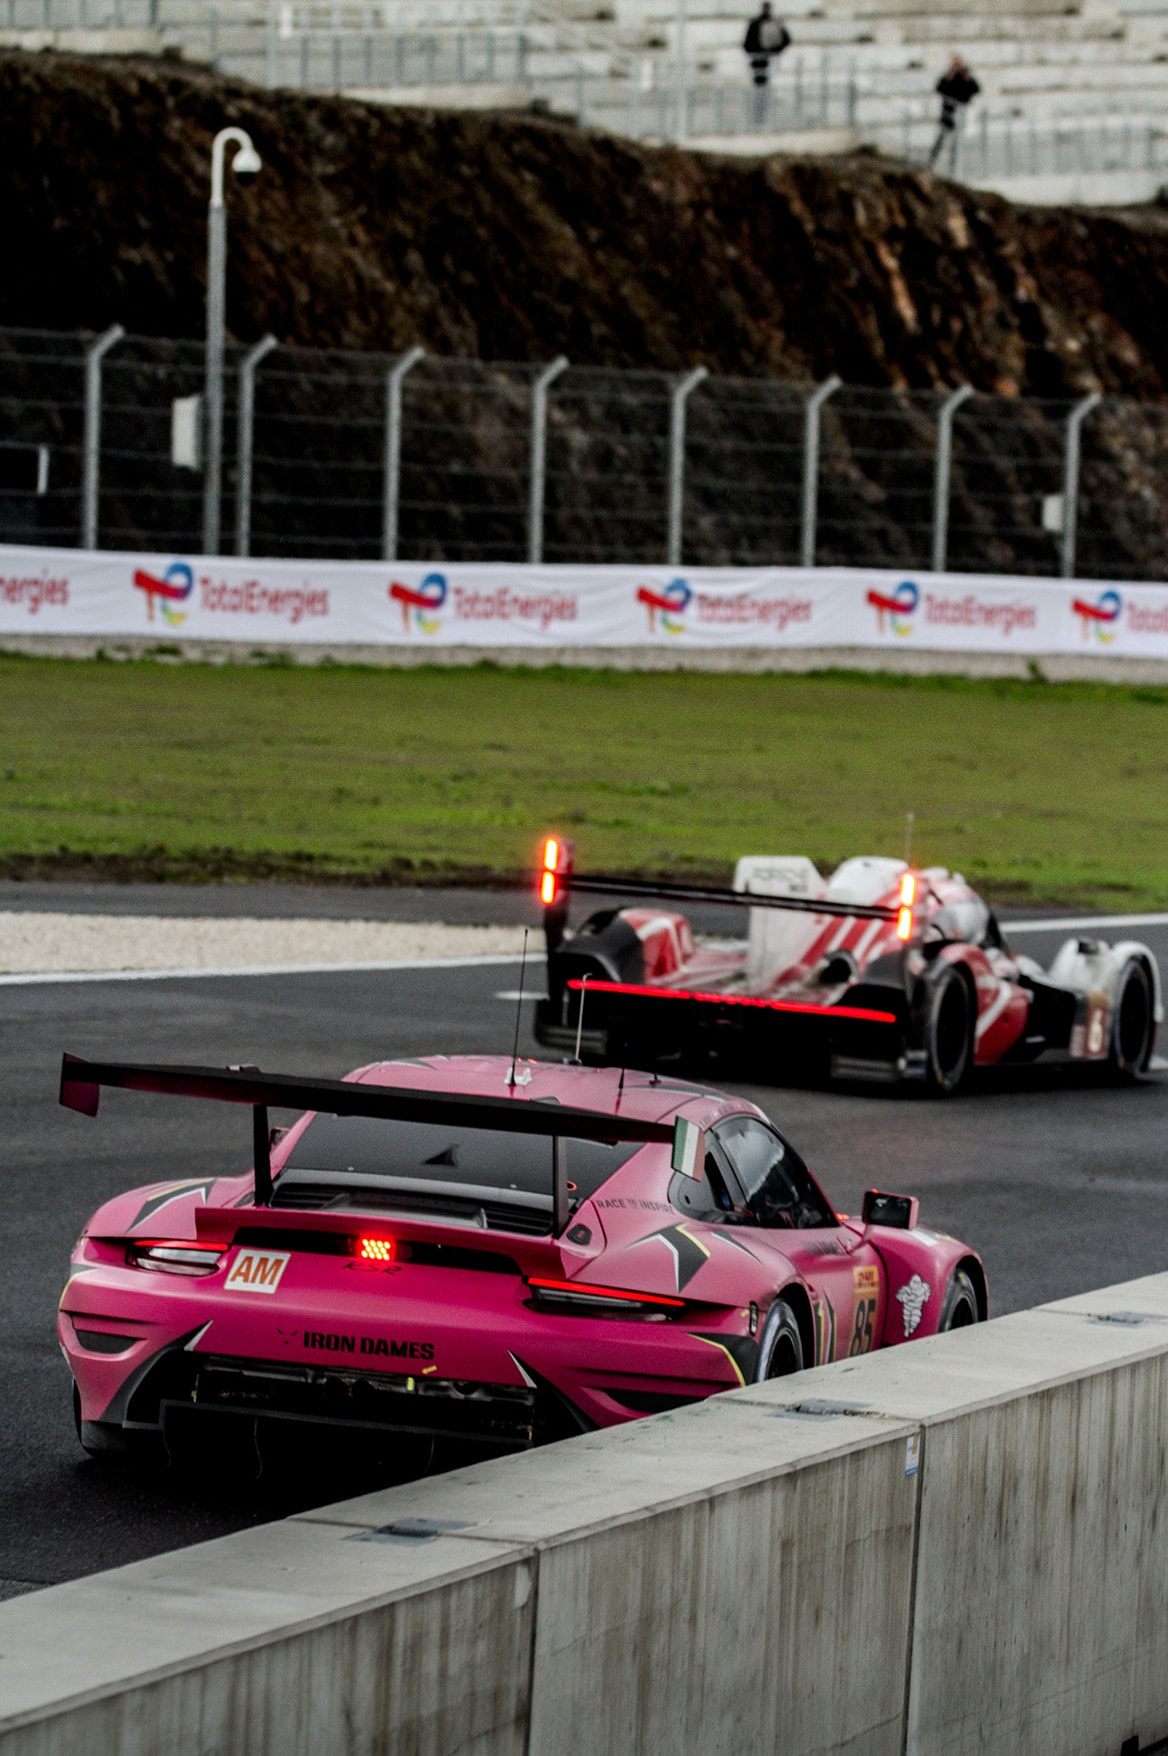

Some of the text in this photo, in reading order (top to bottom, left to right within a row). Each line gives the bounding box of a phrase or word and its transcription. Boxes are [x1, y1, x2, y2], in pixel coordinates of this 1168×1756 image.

[200, 577, 329, 624] TotalEnergies
[453, 586, 577, 630] TotalEnergies
[597, 1199, 626, 1209] RACE
[640, 1200, 675, 1215] INSPIRE
[230, 1256, 284, 1286] AM
[303, 1331, 435, 1360] IRON DAMES
[849, 1298, 876, 1357] 85
